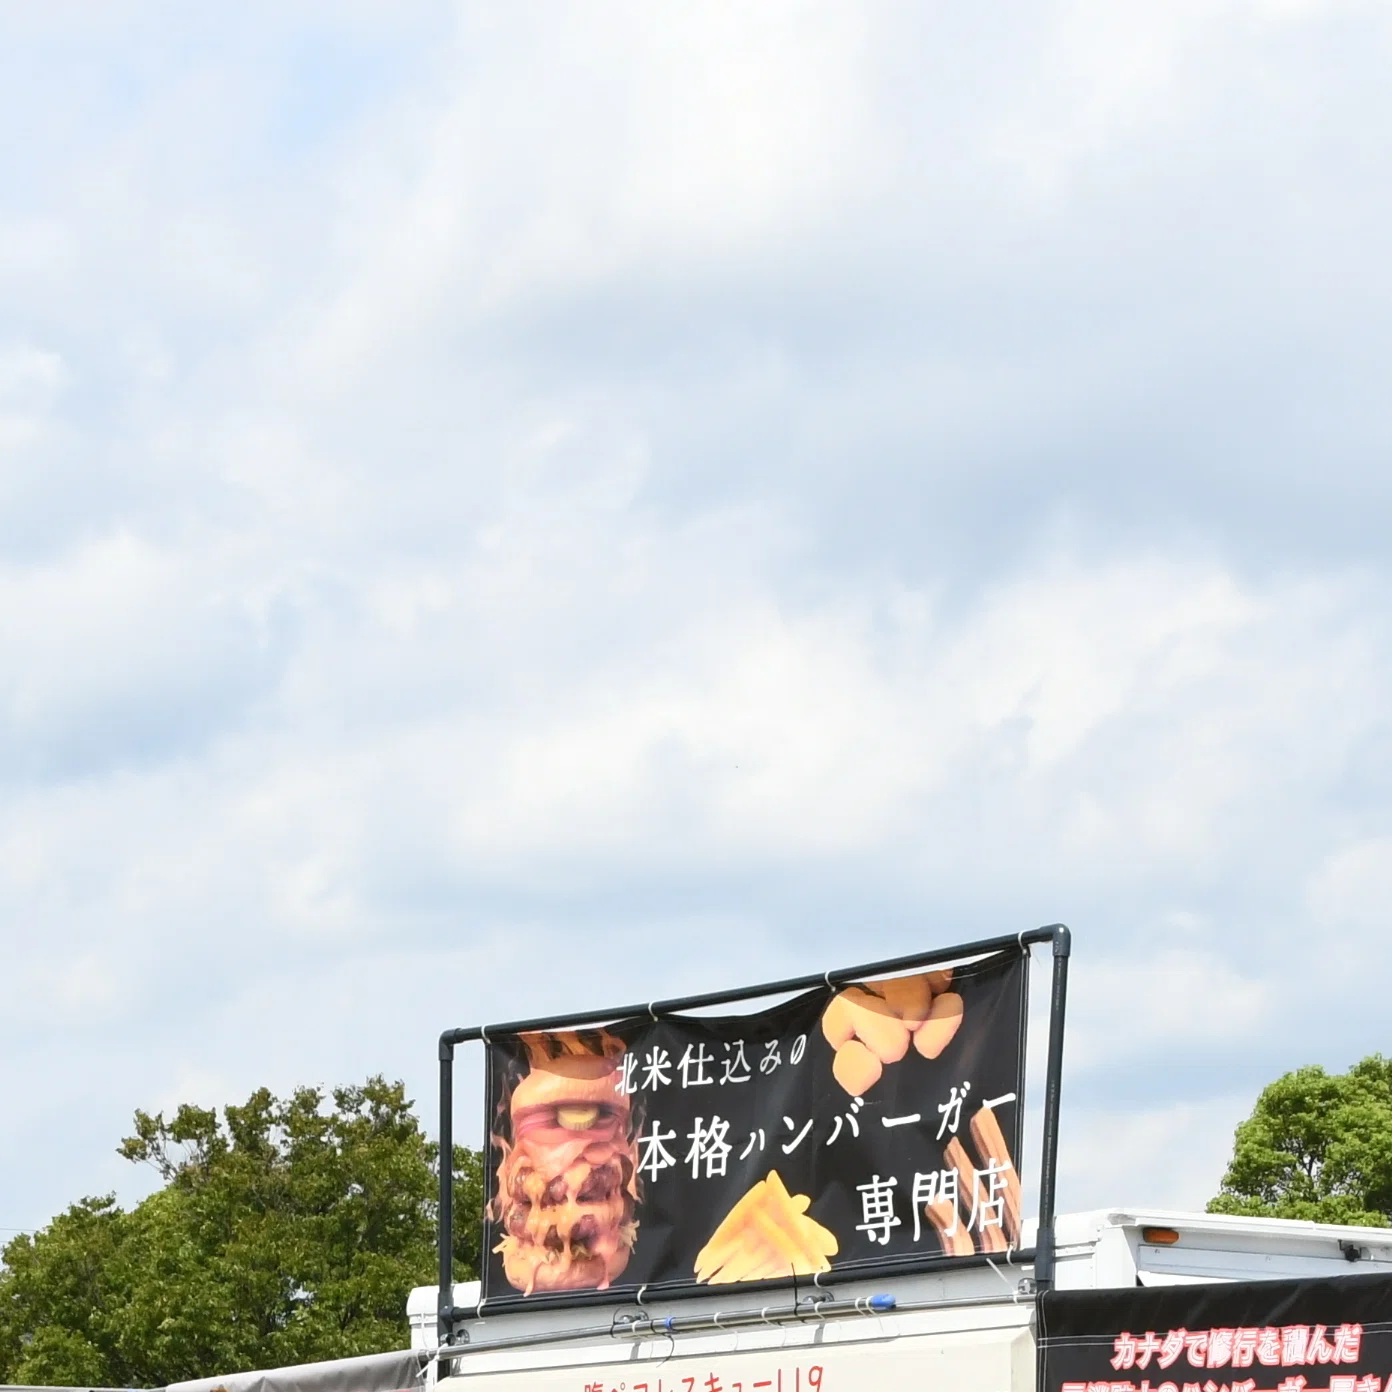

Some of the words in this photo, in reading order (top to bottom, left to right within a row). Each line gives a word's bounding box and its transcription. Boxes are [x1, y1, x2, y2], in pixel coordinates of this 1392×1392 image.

[614, 1033, 807, 1096] 北米仕込みの
[637, 1081, 1017, 1182] 本格ハンバーガー
[856, 1158, 1012, 1245] 専門店
[1111, 1324, 1363, 1369] カナダで修行を積んだ
